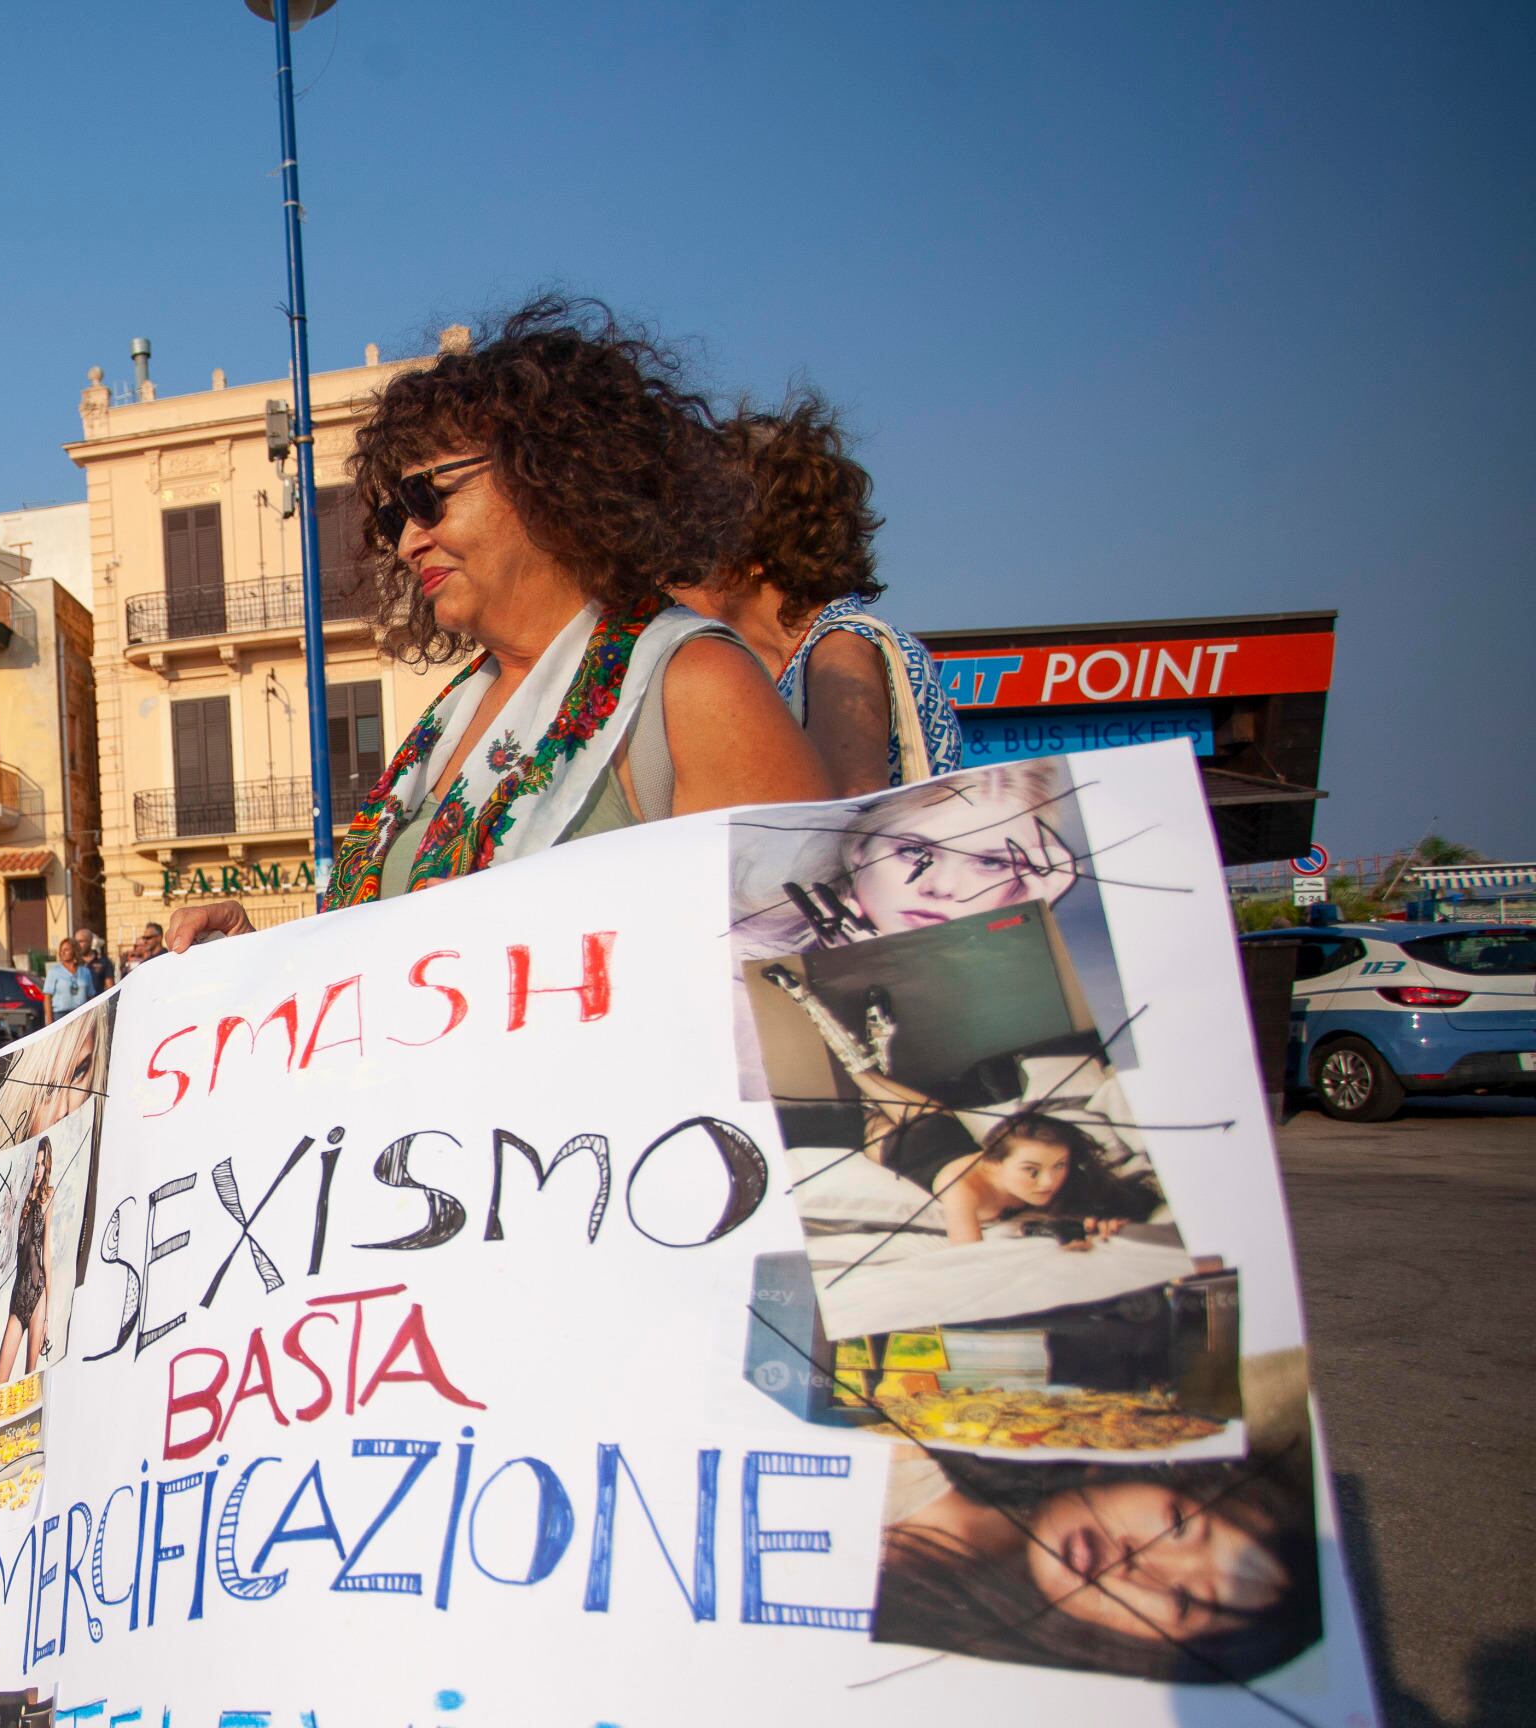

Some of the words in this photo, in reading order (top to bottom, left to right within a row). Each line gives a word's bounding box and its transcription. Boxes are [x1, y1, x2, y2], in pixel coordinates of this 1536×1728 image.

[933, 655, 1023, 705] AT
[1040, 644, 1239, 703] POINT
[969, 727, 992, 756] &
[1004, 723, 1065, 754] BUS
[1075, 718, 1202, 750] TICKETS
[1360, 960, 1407, 975] 113
[143, 930, 618, 1119] SMASH
[163, 1283, 487, 1462] BASTA
